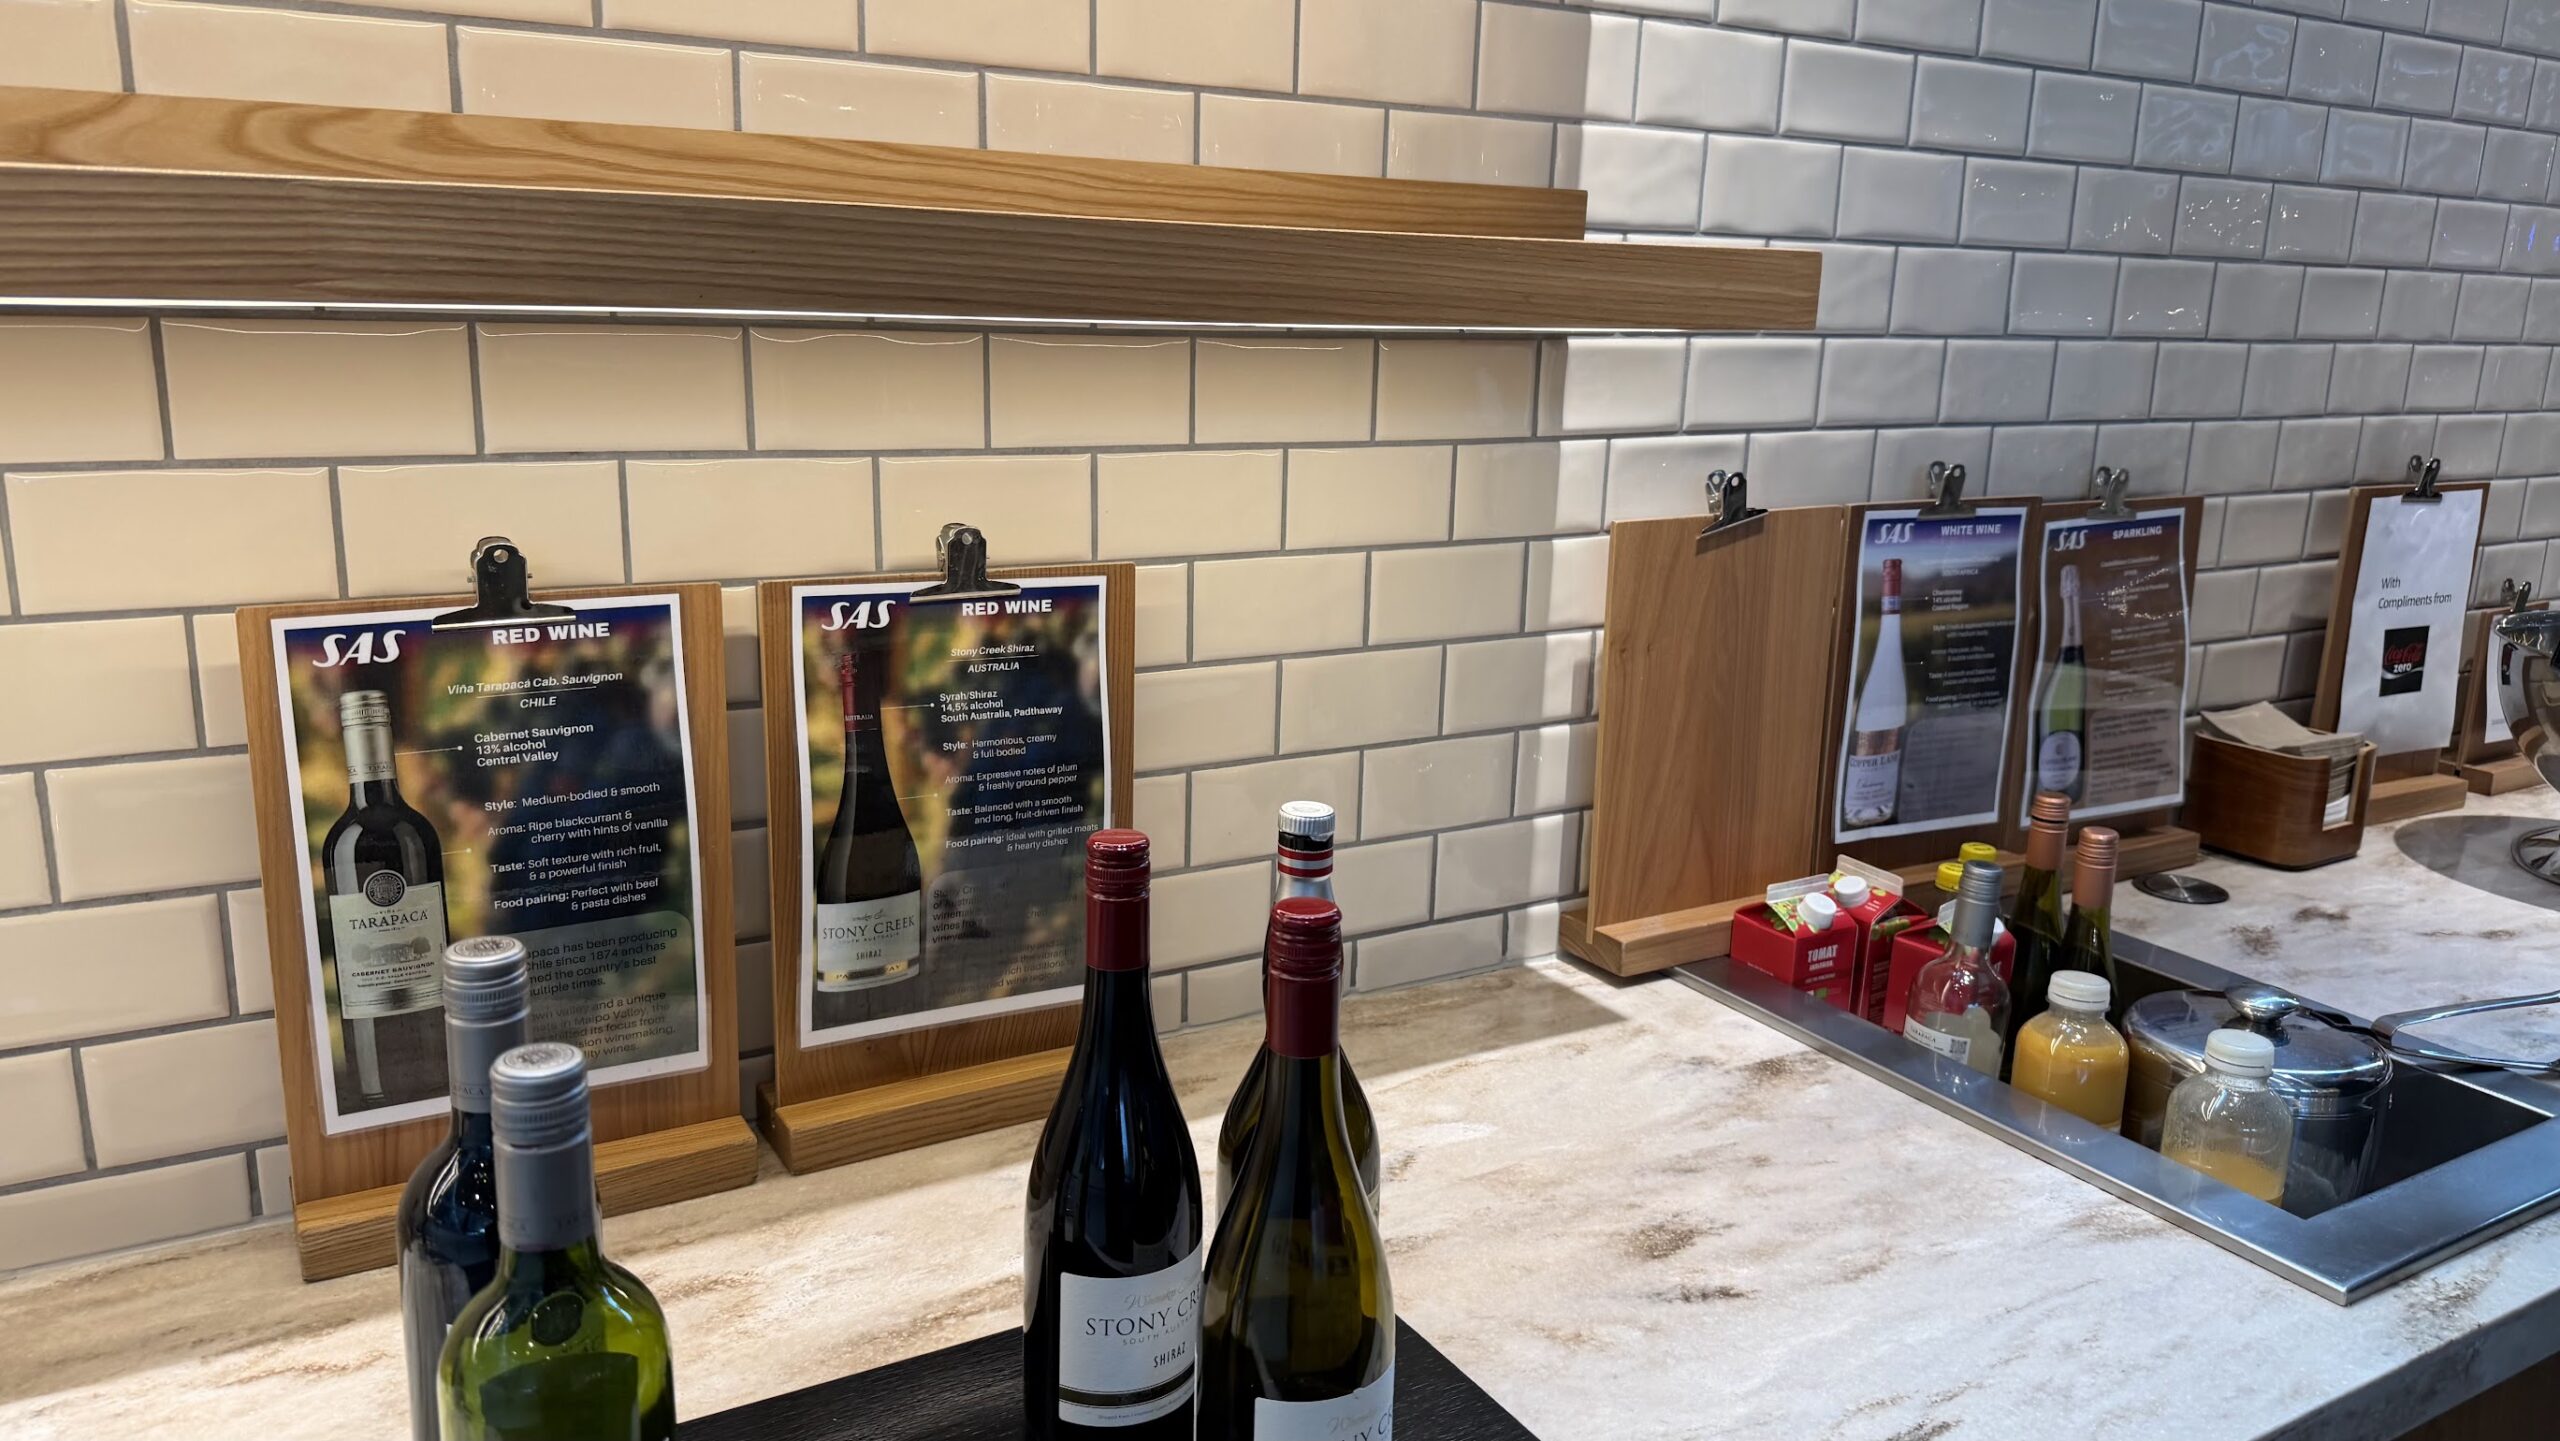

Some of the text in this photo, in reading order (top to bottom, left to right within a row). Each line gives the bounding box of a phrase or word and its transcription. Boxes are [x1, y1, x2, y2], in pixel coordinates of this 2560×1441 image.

[1874, 522, 1916, 544] SAS
[1940, 524, 2002, 536] WHITE WINE
[2112, 526, 2162, 540] SPARKLING
[2054, 530, 2088, 552] SAS
[2381, 576, 2401, 590] With
[962, 599, 1053, 617] RED WINE
[2378, 592, 2452, 611] Compliments from
[821, 600, 896, 630] SAS
[492, 622, 610, 645] RED WINE
[312, 630, 406, 668] SAS
[950, 644, 1035, 658] Stony Creek Shiraz
[967, 662, 1020, 674] AUSTRALIA
[2393, 662, 2412, 674] zero
[447, 672, 623, 696] Viña Tarapacá Cab. Sauvignon
[520, 696, 557, 709] CHILE
[940, 690, 998, 704] Syrah/Shiraz
[941, 699, 1004, 713] 14,5% alcohol
[941, 705, 1064, 724] South Australia, Padthaway
[474, 724, 594, 744] Cabernet Sauvignon
[942, 740, 968, 752] Style:
[1026, 734, 1058, 745] creamy
[476, 739, 547, 756] 13% alcohol
[972, 751, 980, 760] &
[476, 751, 559, 768] Central Valley
[945, 763, 1078, 785] Aroma: Expressive notes of plum
[978, 774, 1078, 792] & freshly ground pepper
[484, 782, 661, 813] Style: Medium-bodied & smooth
[946, 794, 1072, 818] Taste: Balanced with a smooth
[487, 810, 633, 838] Aroma: Ripe blackcurrant &
[974, 804, 1084, 825] and long, fruit-driven finish
[530, 818, 669, 845] cherry with hints of vanilla
[945, 838, 969, 849] Food
[970, 834, 1005, 847] pairing:
[1027, 829, 1046, 840] with
[1046, 826, 1073, 838] grilled
[1074, 823, 1099, 833] meats
[1006, 836, 1069, 852] & hearty dishes
[490, 862, 526, 875] Taste:
[528, 857, 550, 870] Soft
[551, 852, 590, 866] texture
[591, 848, 615, 861] with
[616, 844, 637, 857] rich
[529, 860, 627, 882] & a powerful finish
[494, 878, 660, 910] Food pairing: Perfect with beef
[570, 892, 647, 912] & pasta dishes
[823, 924, 868, 940] STONY
[874, 915, 914, 934] CREEK
[564, 928, 678, 955] has been producing
[555, 954, 587, 968] since
[590, 949, 618, 962] 1874
[621, 944, 644, 958] and
[645, 941, 667, 954] has
[1808, 944, 1838, 963] TOMAT
[555, 956, 657, 981] the country's best
[530, 978, 606, 998] ultiple times.
[626, 991, 667, 1007] unique
[1085, 1306, 1172, 1336] STONY
[1153, 1341, 1186, 1368] SHIRAZ
